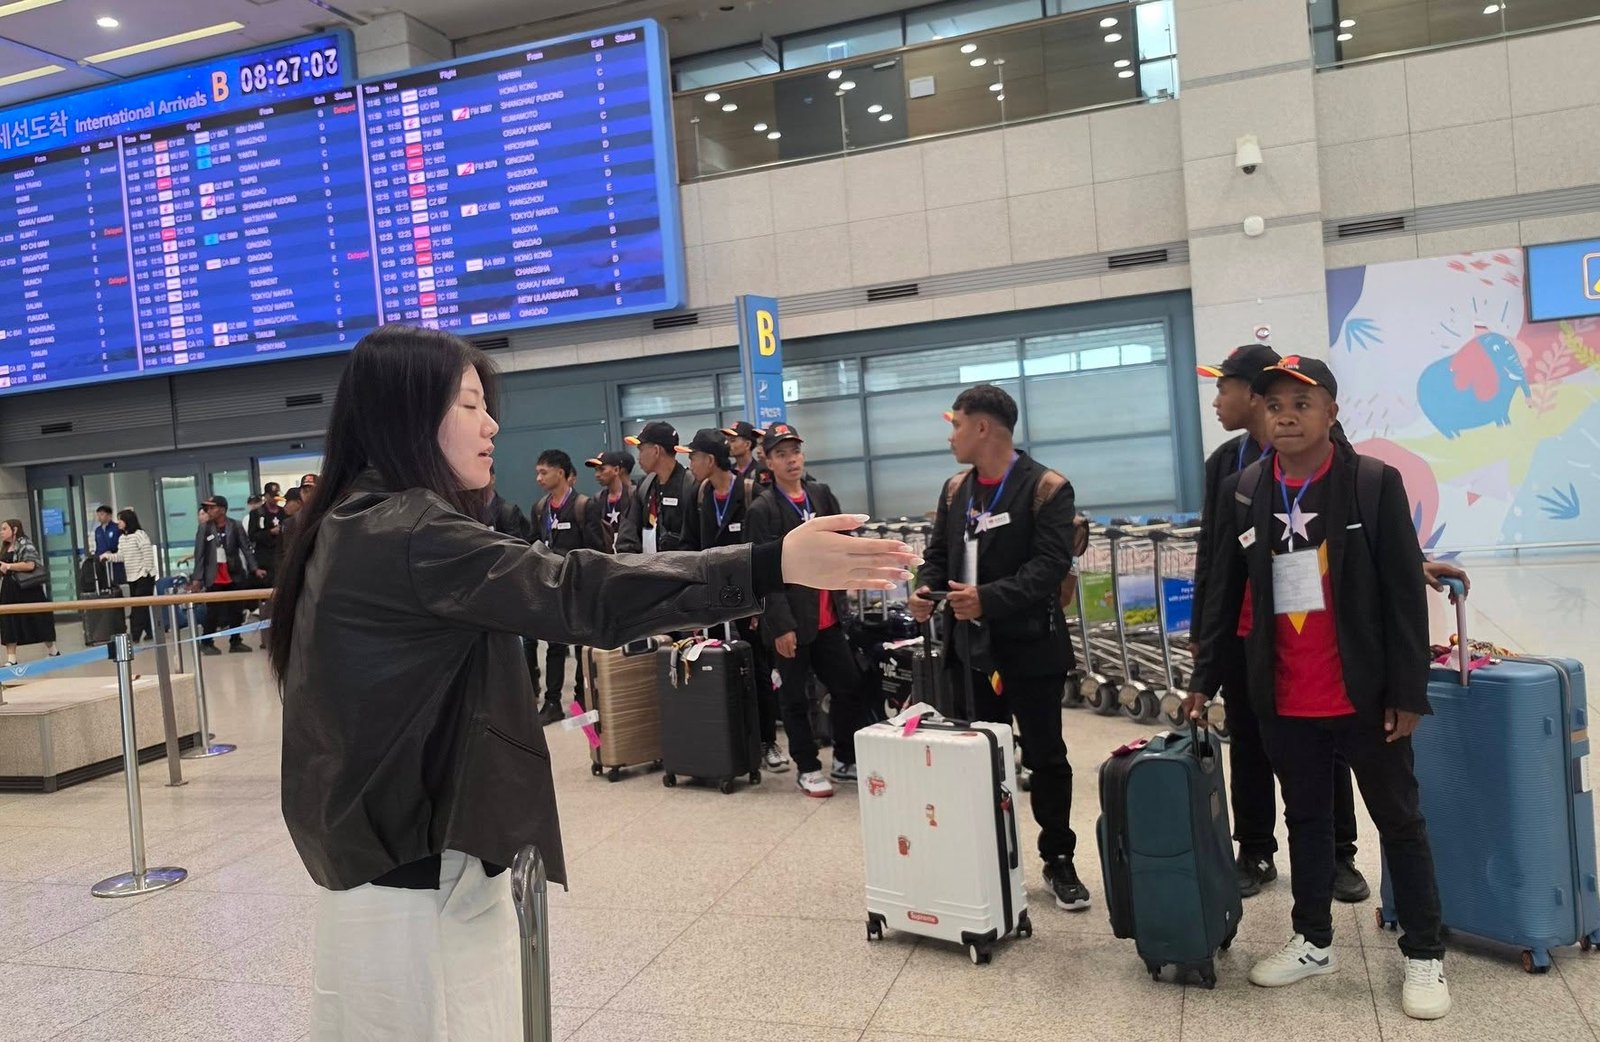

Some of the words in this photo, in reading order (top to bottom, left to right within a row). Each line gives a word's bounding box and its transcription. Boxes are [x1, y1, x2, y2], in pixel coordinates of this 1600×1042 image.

[75, 101, 155, 133] International
[158, 91, 207, 115] Arrivals
[211, 71, 229, 102] B
[756, 309, 776, 356] B
